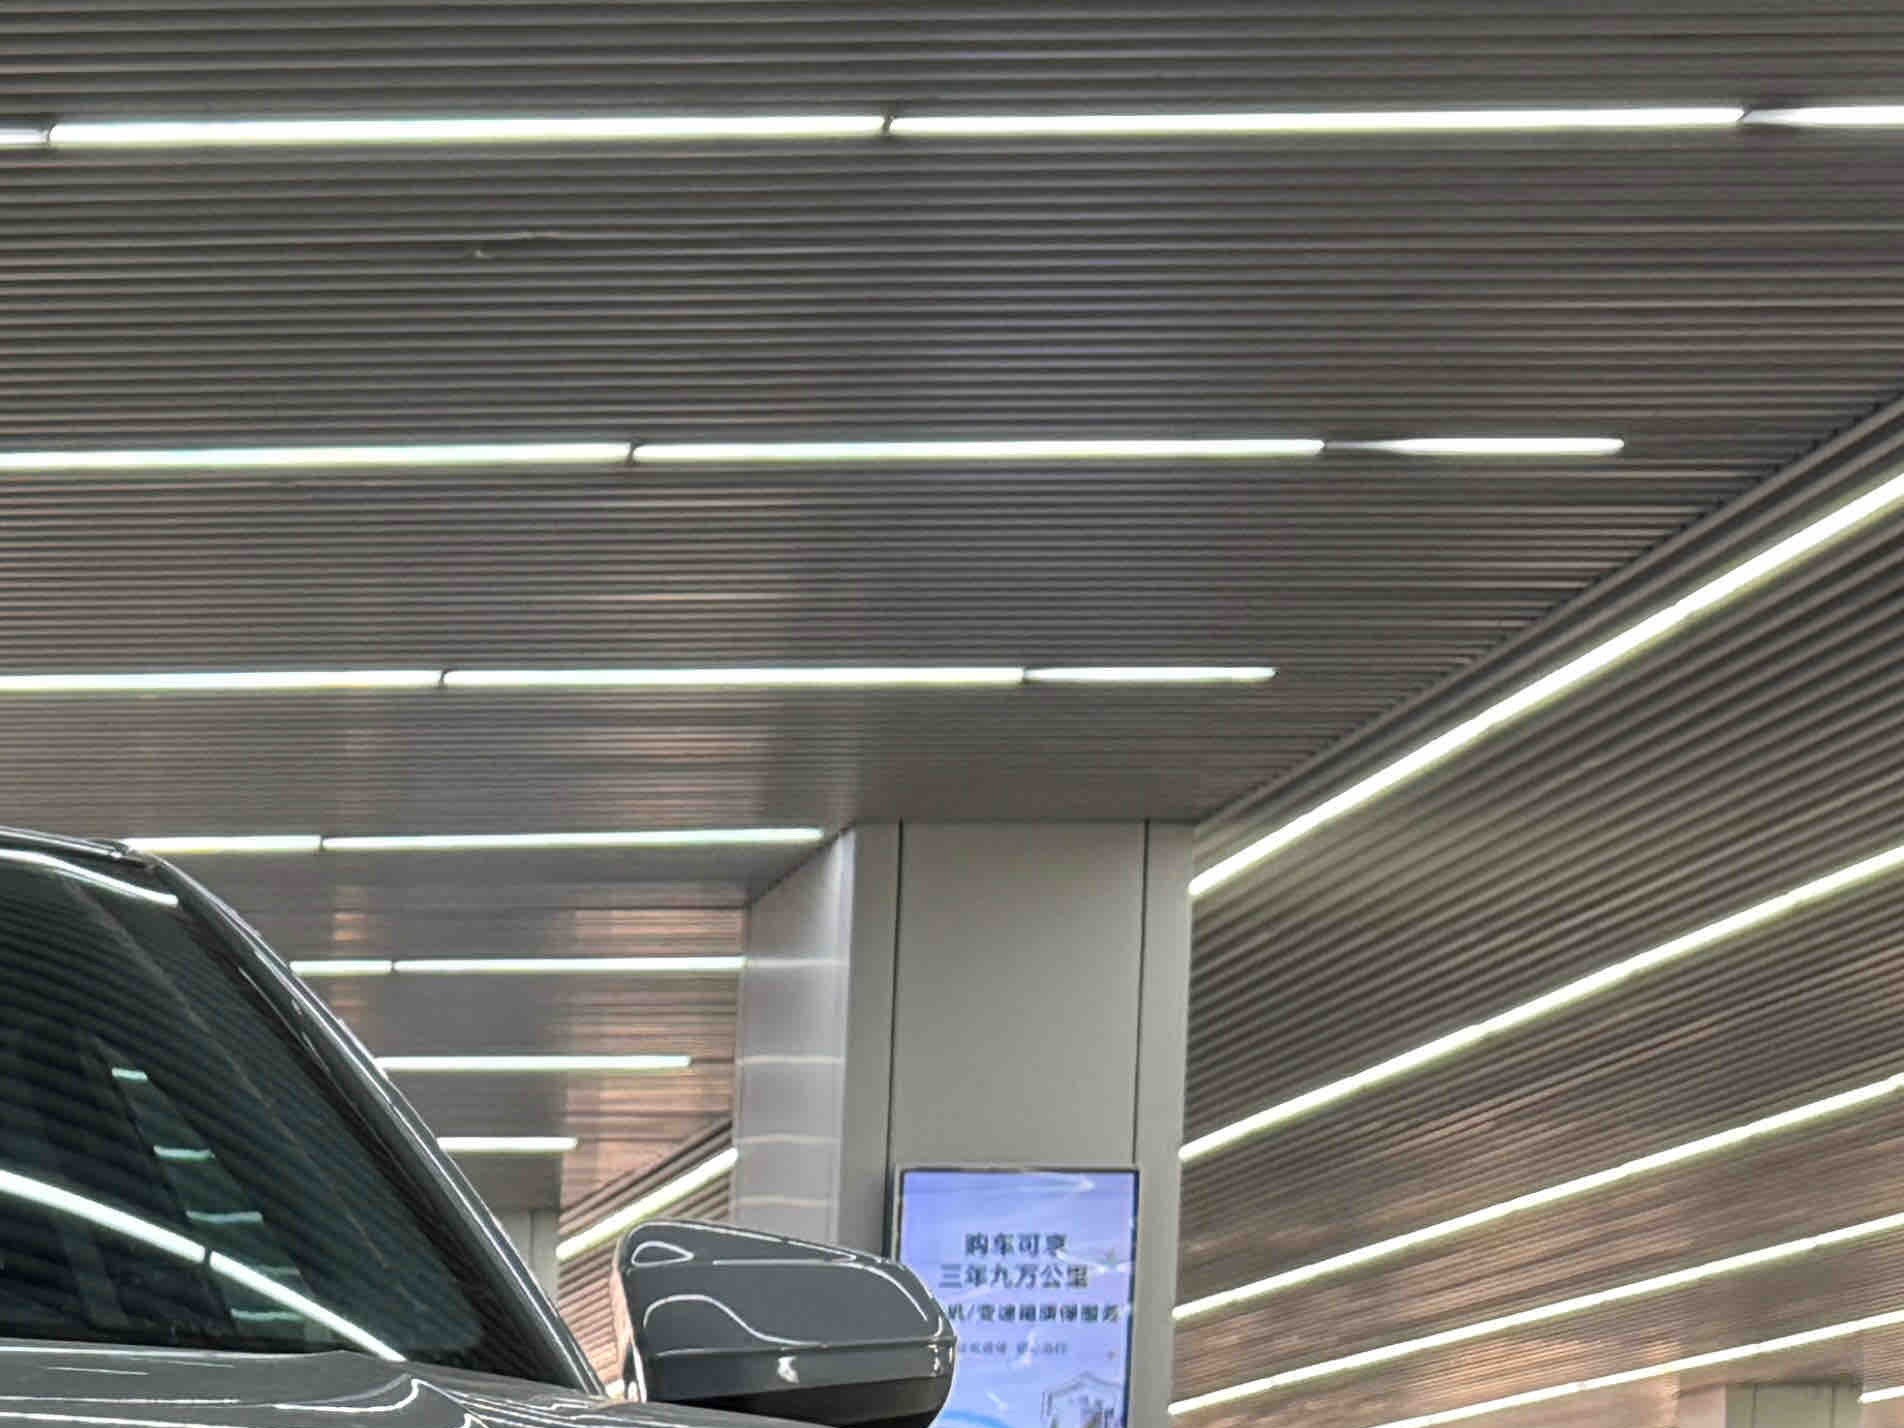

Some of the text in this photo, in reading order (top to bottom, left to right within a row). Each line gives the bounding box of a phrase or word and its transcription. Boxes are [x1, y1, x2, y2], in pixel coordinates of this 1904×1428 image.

[939, 1263, 1089, 1289] 三年九万公里
